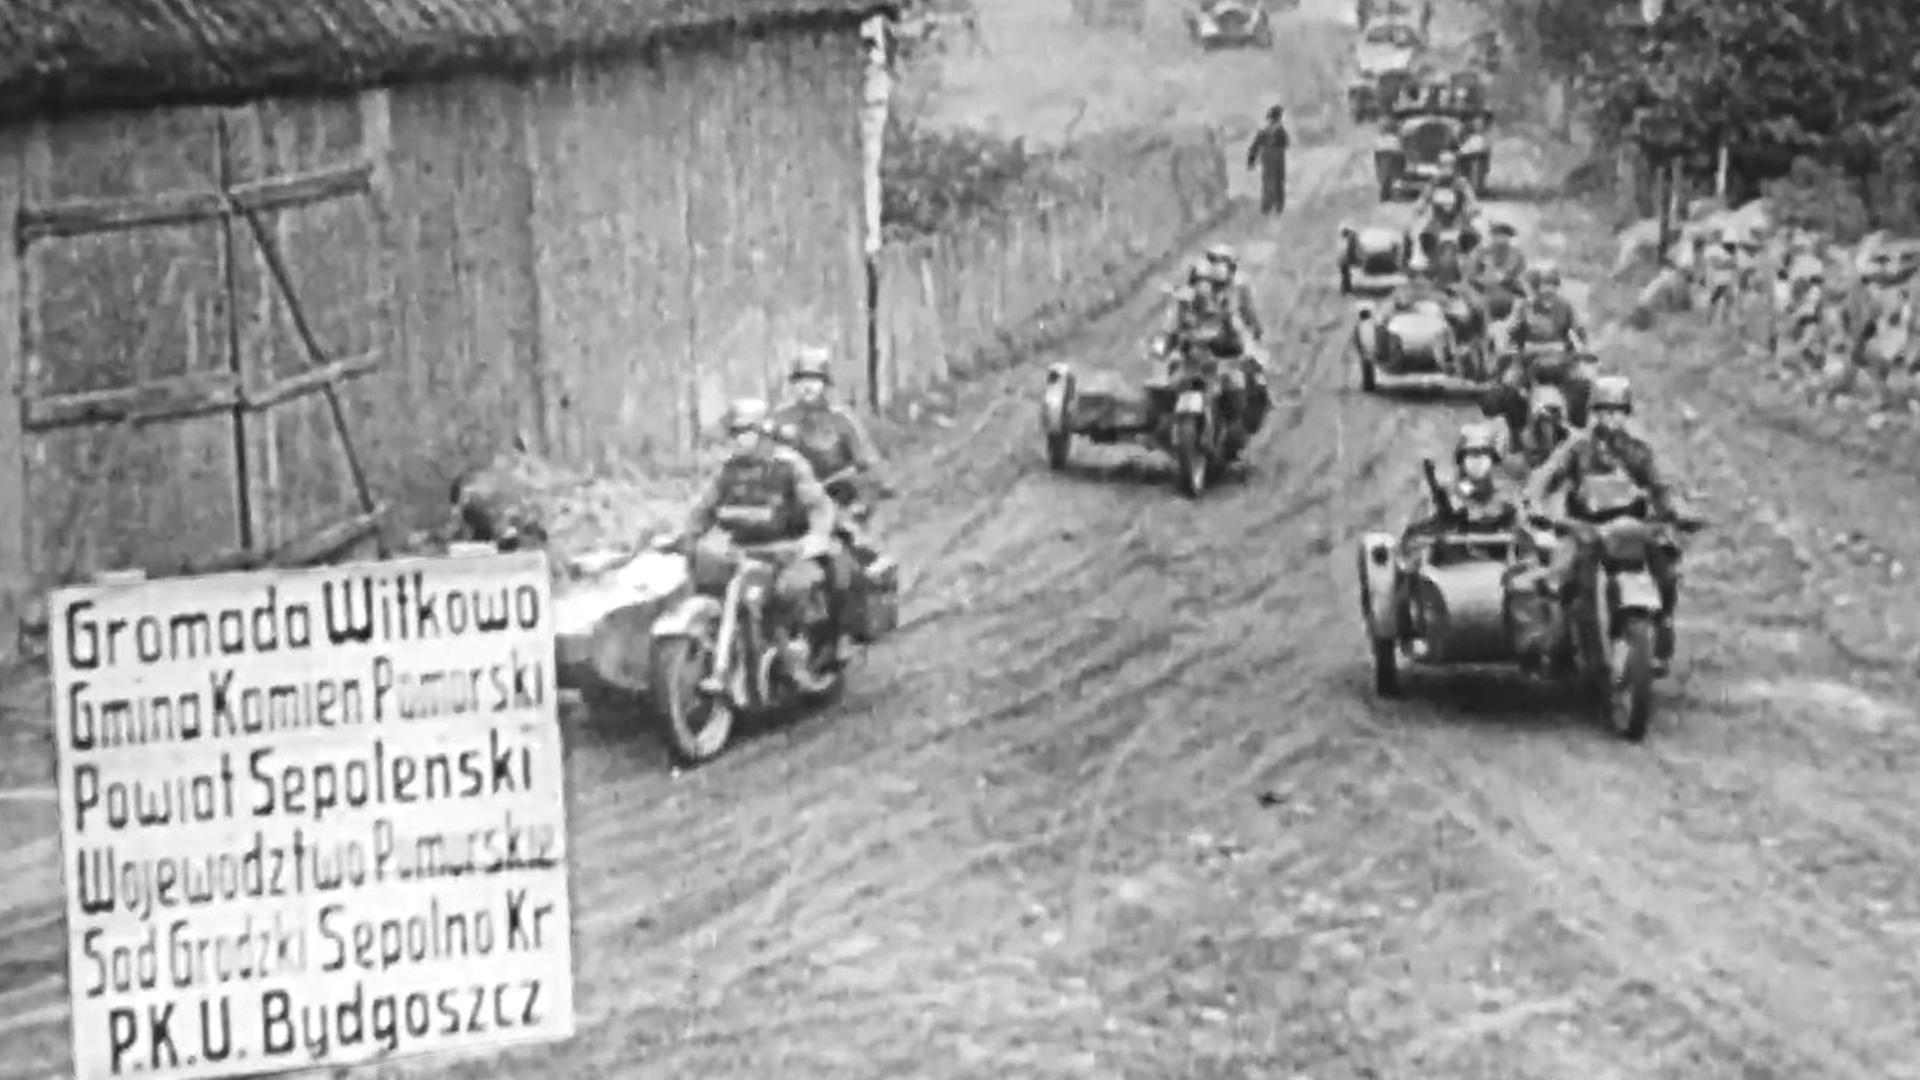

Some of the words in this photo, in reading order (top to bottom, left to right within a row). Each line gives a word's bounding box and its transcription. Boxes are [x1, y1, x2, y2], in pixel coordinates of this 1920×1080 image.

[65, 585, 310, 671] Gromada
[68, 681, 201, 750] Gmina
[210, 668, 362, 738] Kamien
[75, 752, 236, 832] Powiat
[78, 829, 366, 922] Wojewodztwo
[83, 927, 157, 997] Sad
[320, 898, 495, 972] Sepolno
[261, 979, 542, 1060] Bydgoszcz
